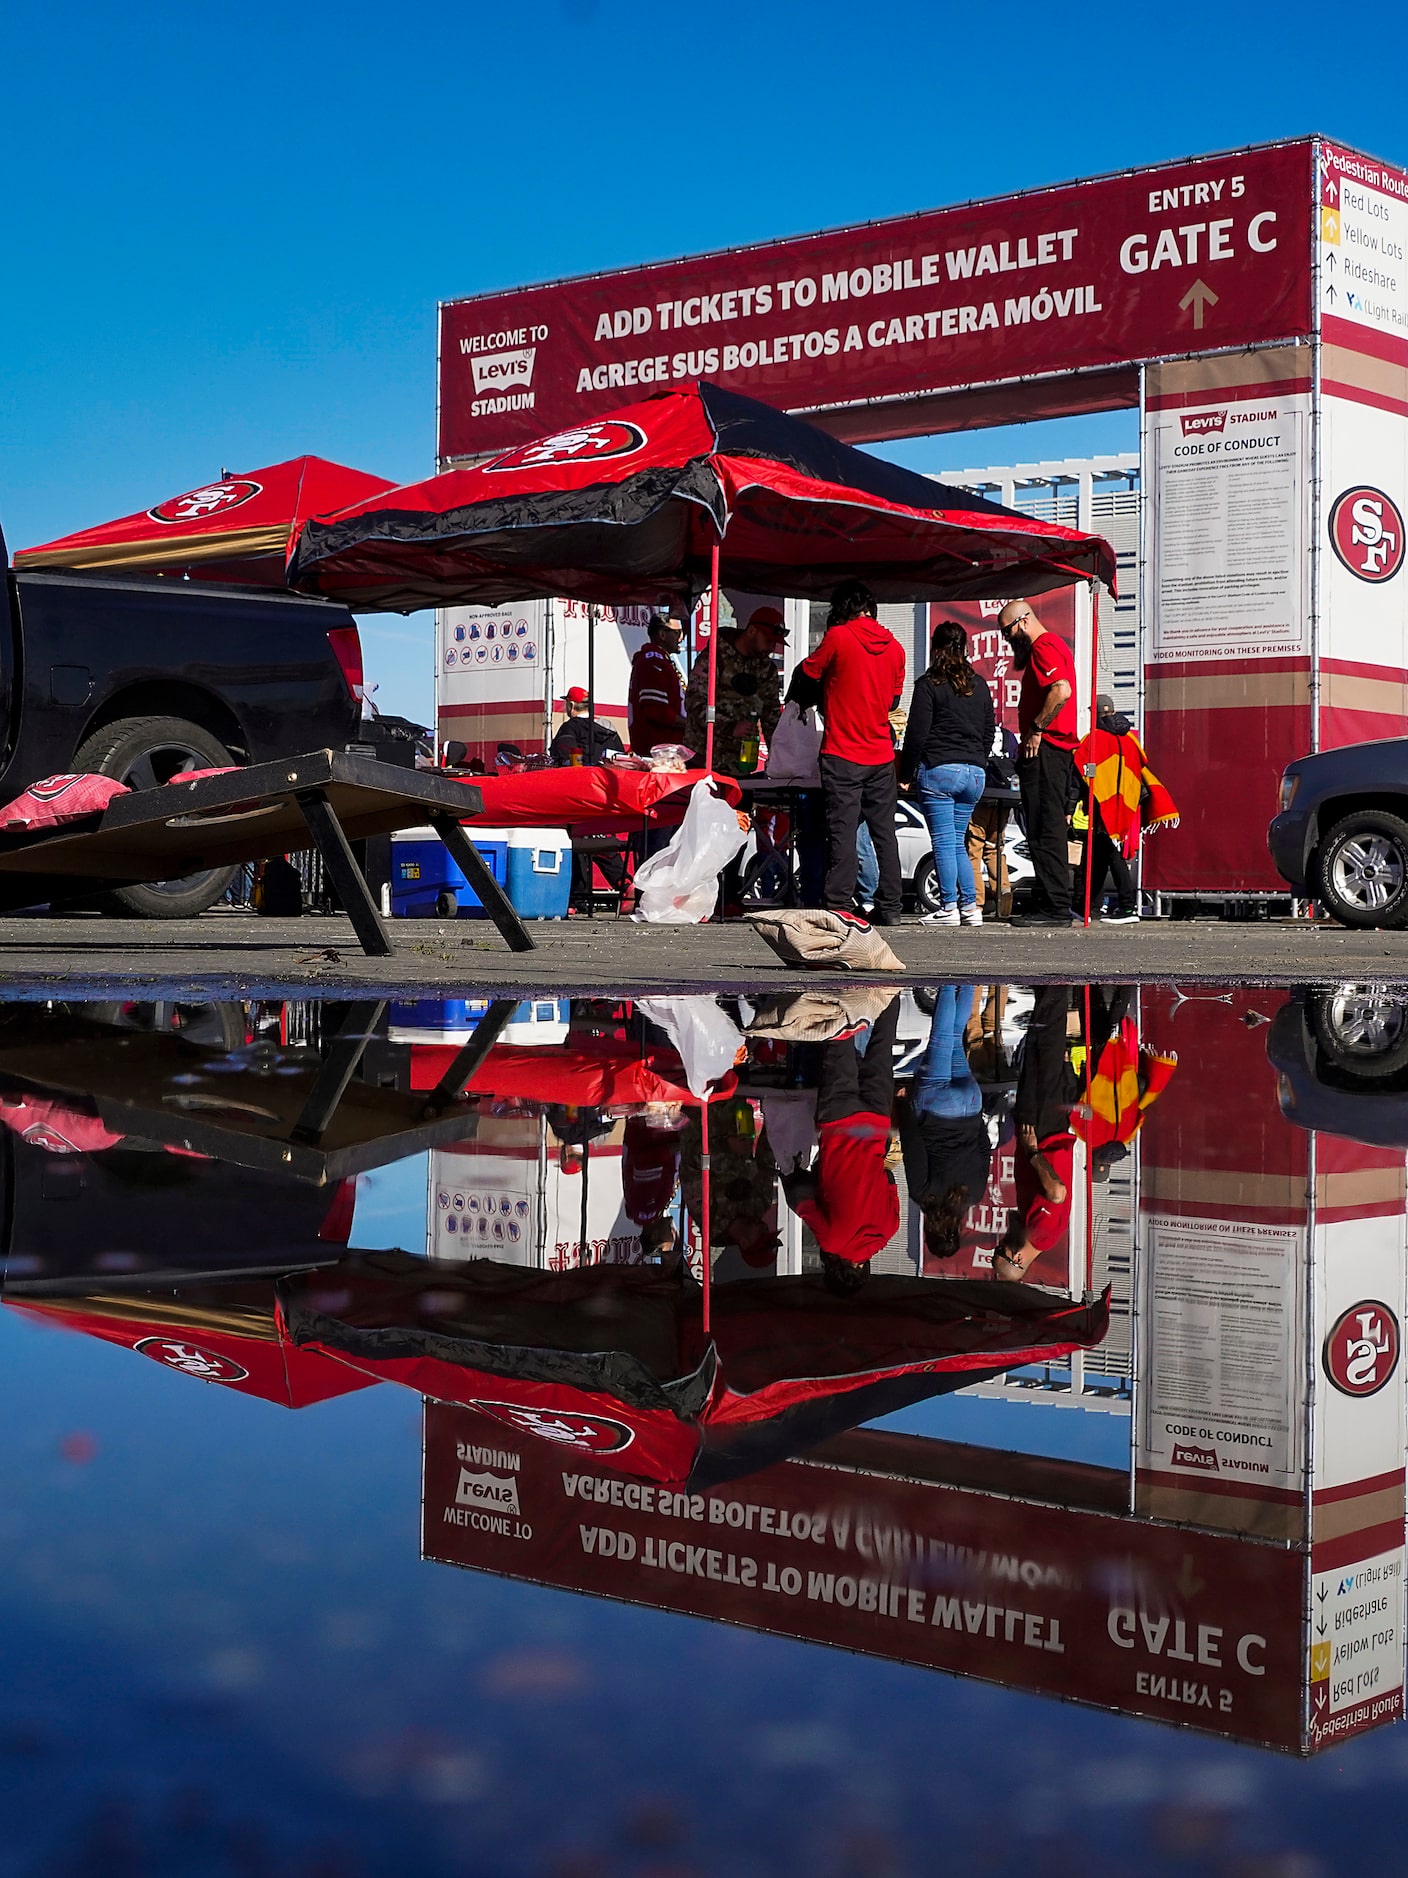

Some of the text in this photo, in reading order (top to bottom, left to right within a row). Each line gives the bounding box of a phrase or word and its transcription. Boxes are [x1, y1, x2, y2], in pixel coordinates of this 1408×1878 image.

[1325, 148, 1380, 188] Pedestrian
[1148, 176, 1246, 214] ENTRY 5
[1344, 188, 1390, 222] Red Lots
[1119, 210, 1278, 275] GATE C
[1344, 222, 1403, 261] Yellow Lots
[594, 228, 1080, 342] ADD TICKETS TO MOBILE WALLET
[1344, 257, 1397, 292] Rideshare
[1364, 299, 1390, 321] (Light
[460, 323, 549, 356] WELCOME TO
[576, 284, 1103, 393] AGREGE SUS BOLETOS A CARTERA MÓVIL
[470, 391, 536, 418] STADIUM
[1229, 410, 1278, 424] STADIUM
[1174, 436, 1281, 457] CODE OF CONDUCT
[1153, 644, 1302, 660] VIDEO MONITORING ON THESE PREMISES
